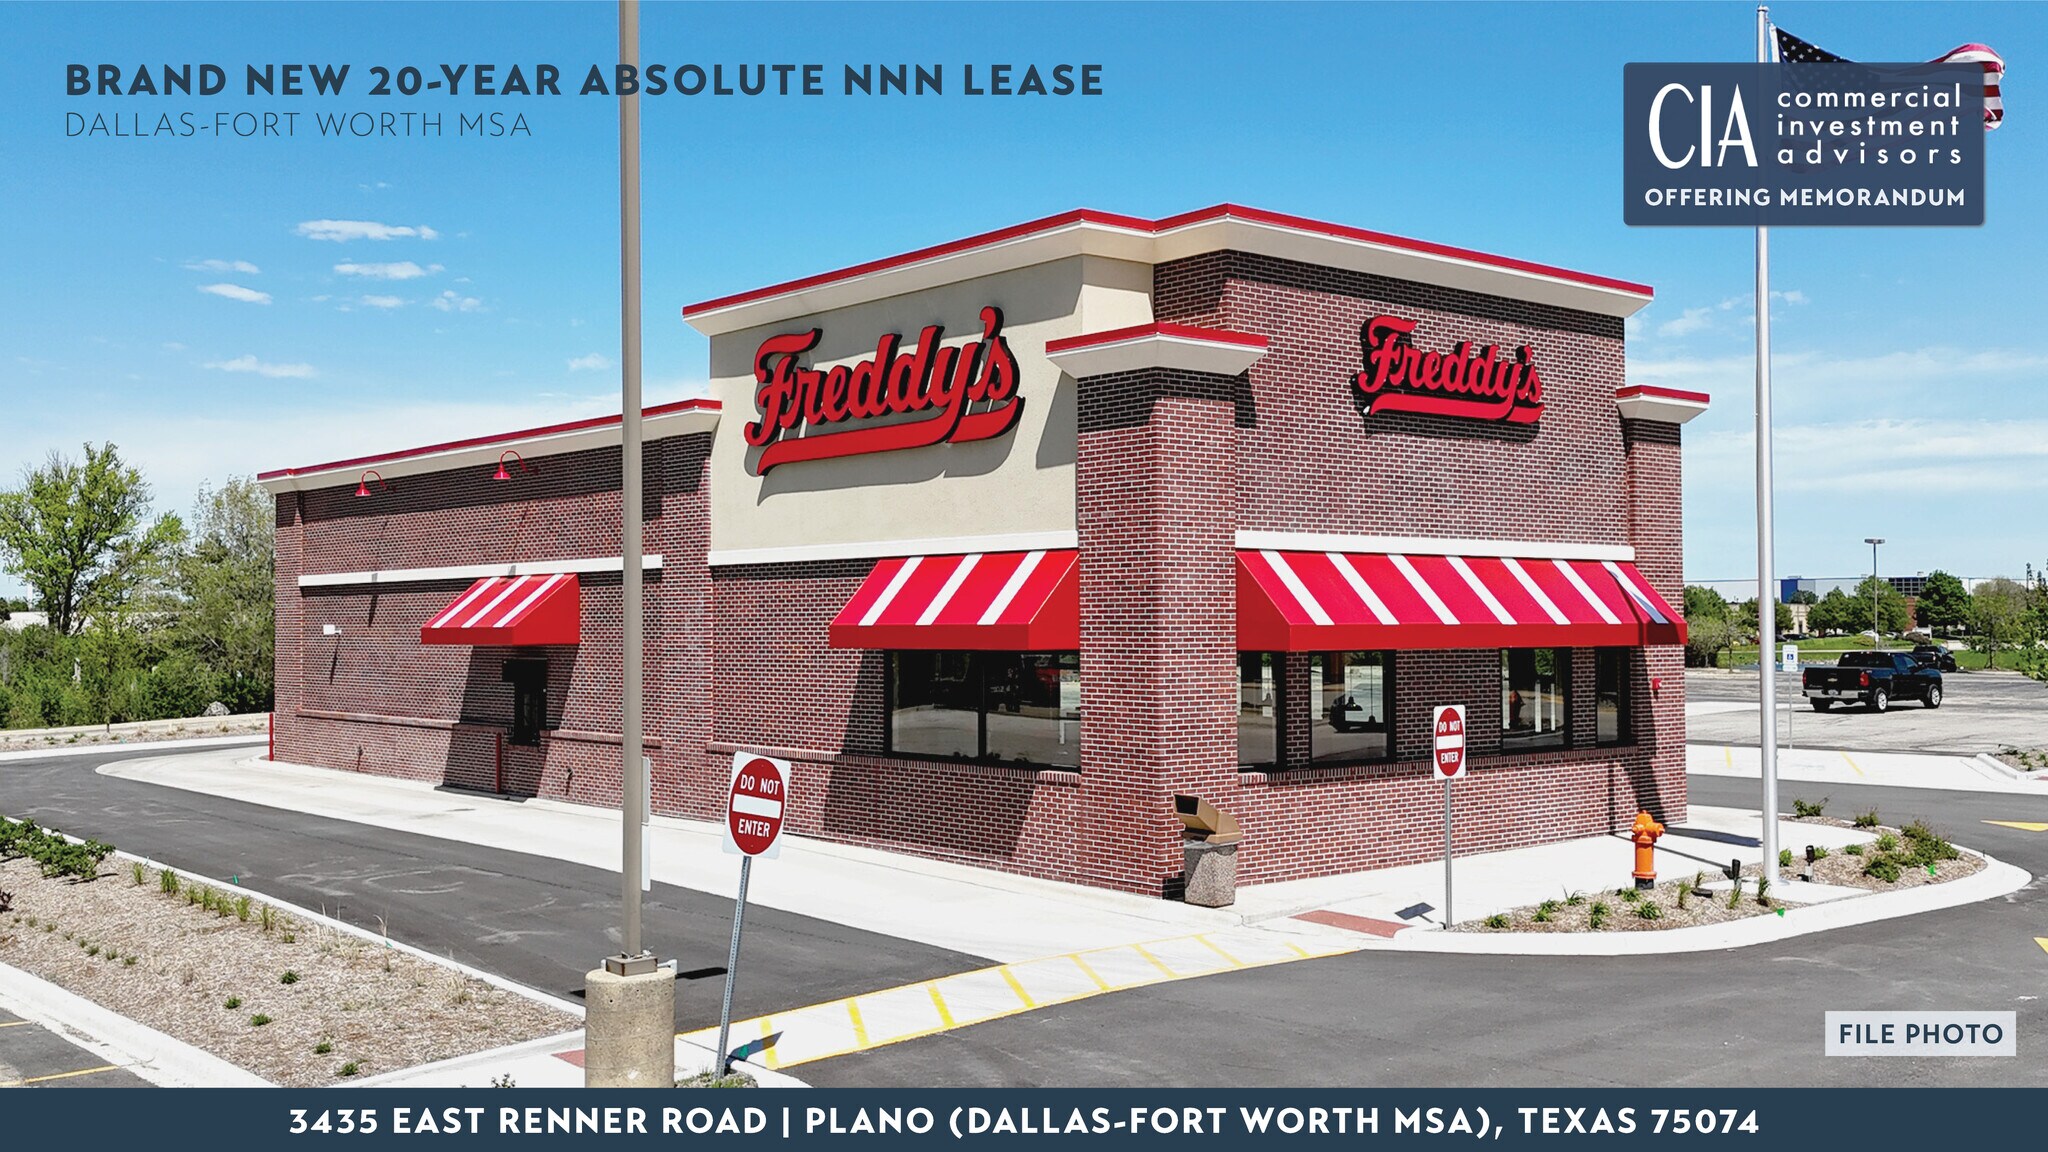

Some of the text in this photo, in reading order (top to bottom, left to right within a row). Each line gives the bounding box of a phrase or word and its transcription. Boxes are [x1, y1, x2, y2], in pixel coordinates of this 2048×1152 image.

[1357, 314, 1546, 424] Freddy's
[744, 306, 1025, 476] Freddy's
[1439, 720, 1460, 733] DO NOT
[1441, 751, 1459, 765] ENTER
[740, 774, 780, 795] DO NOT
[738, 818, 770, 838] ENTER
